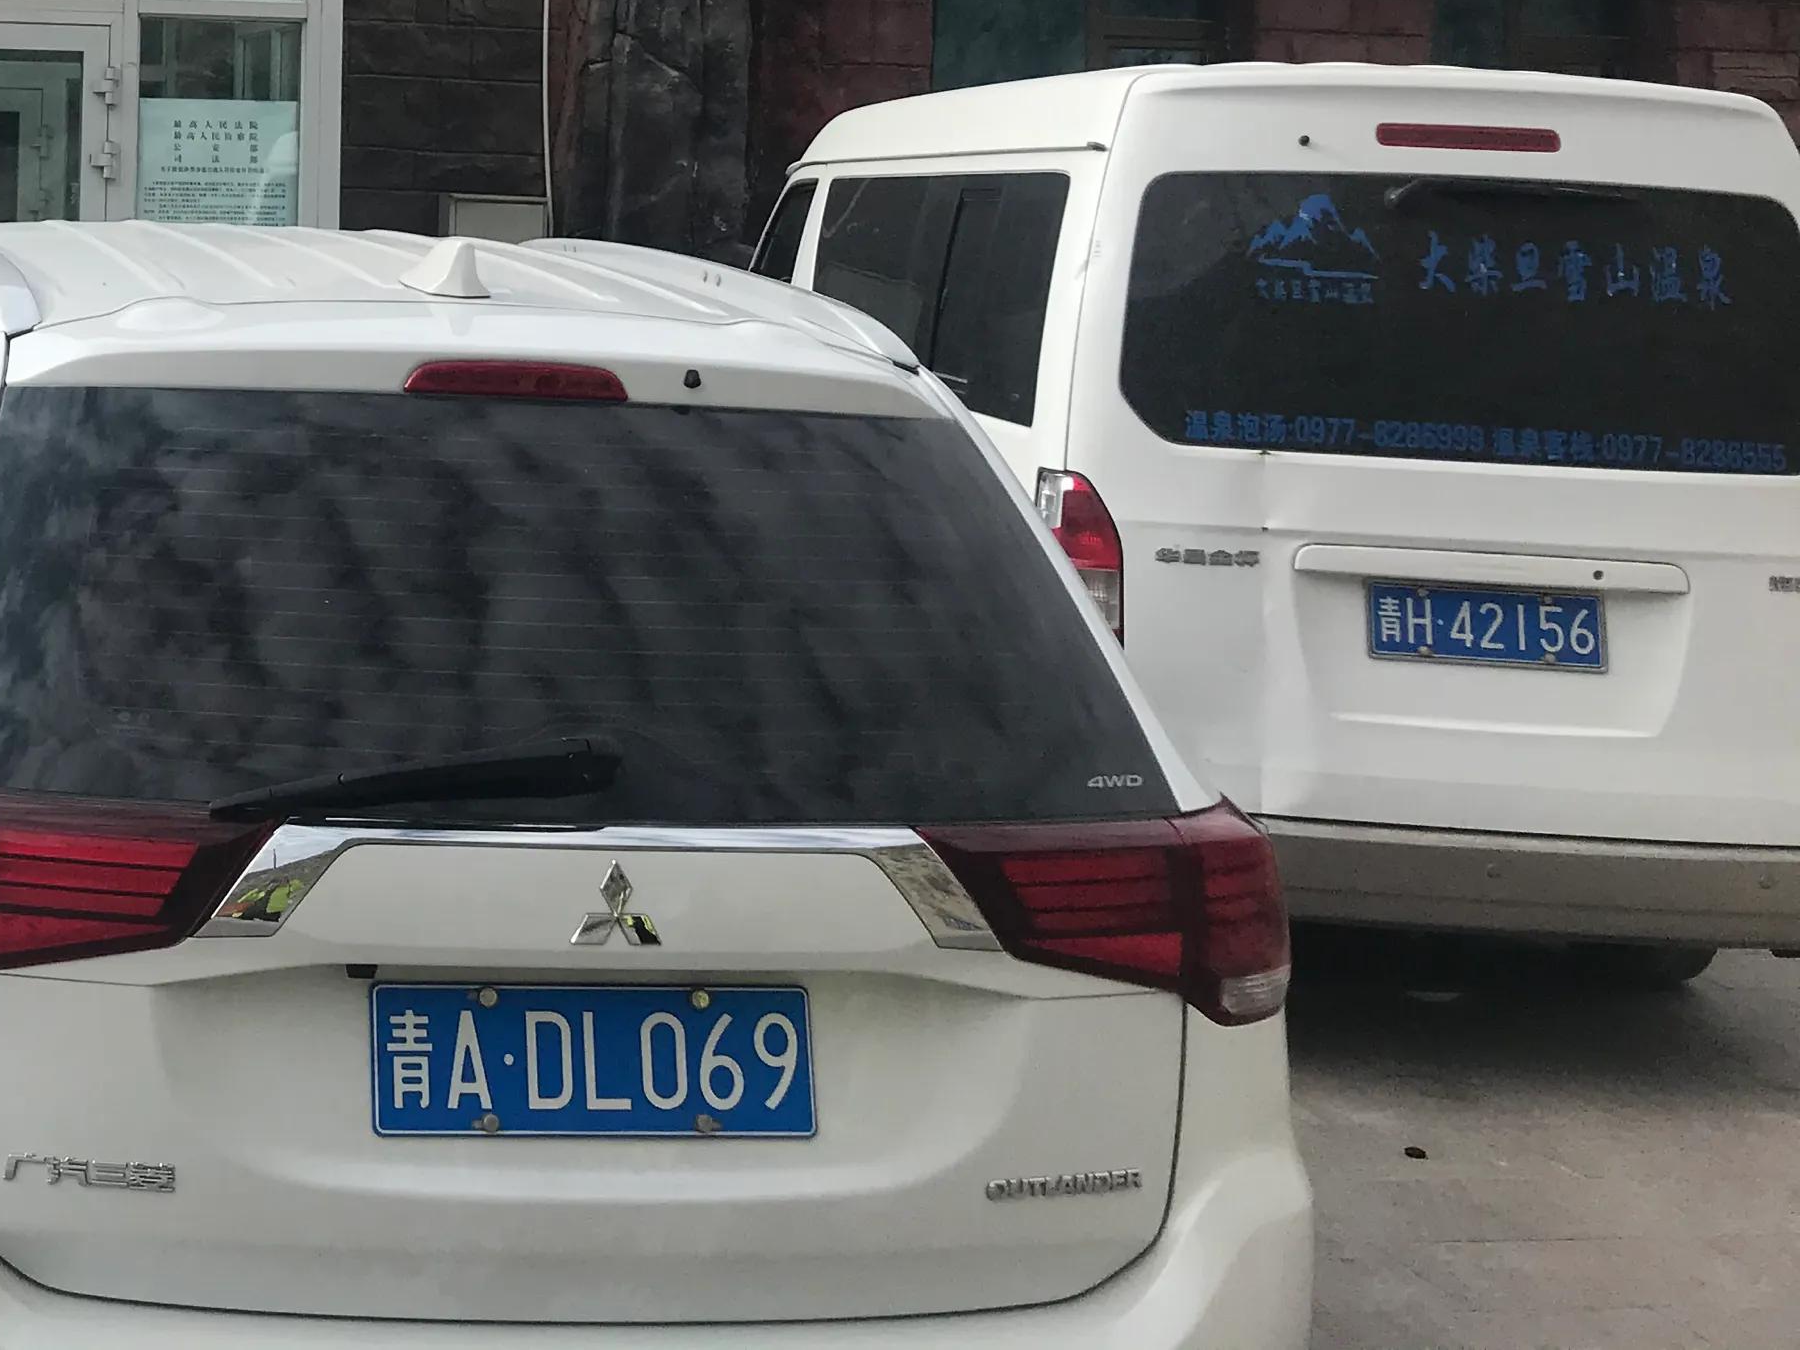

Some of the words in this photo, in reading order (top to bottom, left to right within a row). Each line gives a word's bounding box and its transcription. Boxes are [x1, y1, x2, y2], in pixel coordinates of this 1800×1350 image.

[1418, 230, 1732, 310] 大柴旦雪山温泉
[1378, 596, 1595, 655] 青H·42156
[1087, 774, 1143, 788] 4WD
[386, 1009, 798, 1110] 青A·DL069
[986, 1169, 1142, 1201] OUTLANDER
